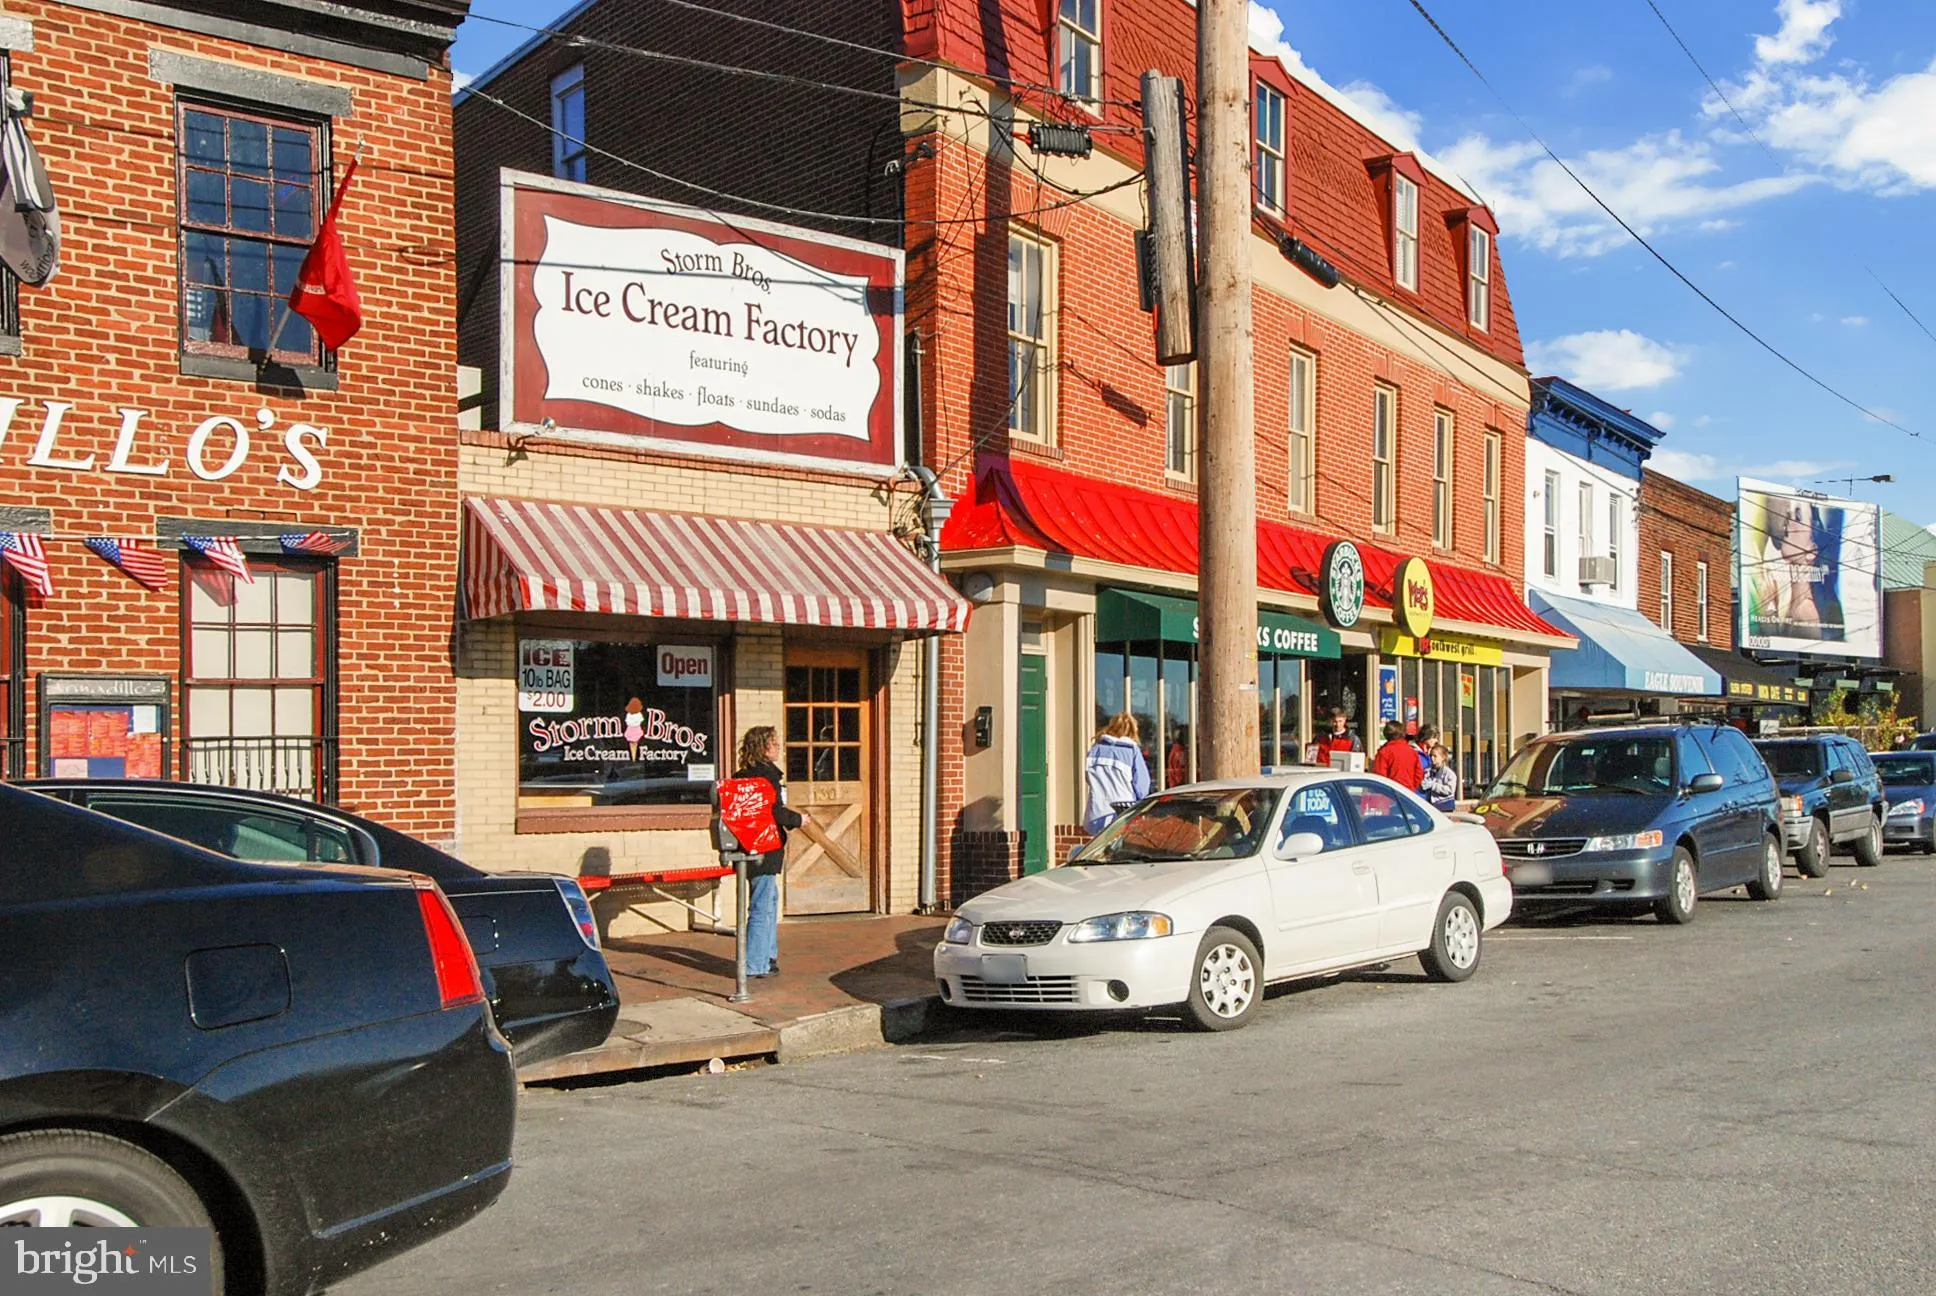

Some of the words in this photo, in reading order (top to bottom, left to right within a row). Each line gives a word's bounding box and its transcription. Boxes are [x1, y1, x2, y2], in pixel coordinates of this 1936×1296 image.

[660, 248, 723, 275] Storm
[731, 252, 772, 295] Bros.
[561, 270, 611, 317] Ice
[622, 282, 733, 337] Cream
[744, 302, 858, 368] Factory
[689, 350, 749, 378] featuring
[582, 375, 623, 392] cones
[636, 378, 684, 400] shakes
[698, 386, 735, 407] floats
[746, 397, 800, 416] sundaes
[810, 405, 846, 422] sodas
[1274, 628, 1318, 652] COFFEE
[522, 644, 571, 667] ICE
[662, 652, 708, 679] Open
[546, 669, 571, 688] BAG
[527, 690, 565, 708] $2.00
[529, 716, 624, 752] Storm
[644, 707, 708, 756] Bros.
[563, 745, 583, 761] Ice
[585, 745, 631, 761] Cream
[638, 745, 689, 765] Factory
[1307, 798, 1330, 811] TODAY
